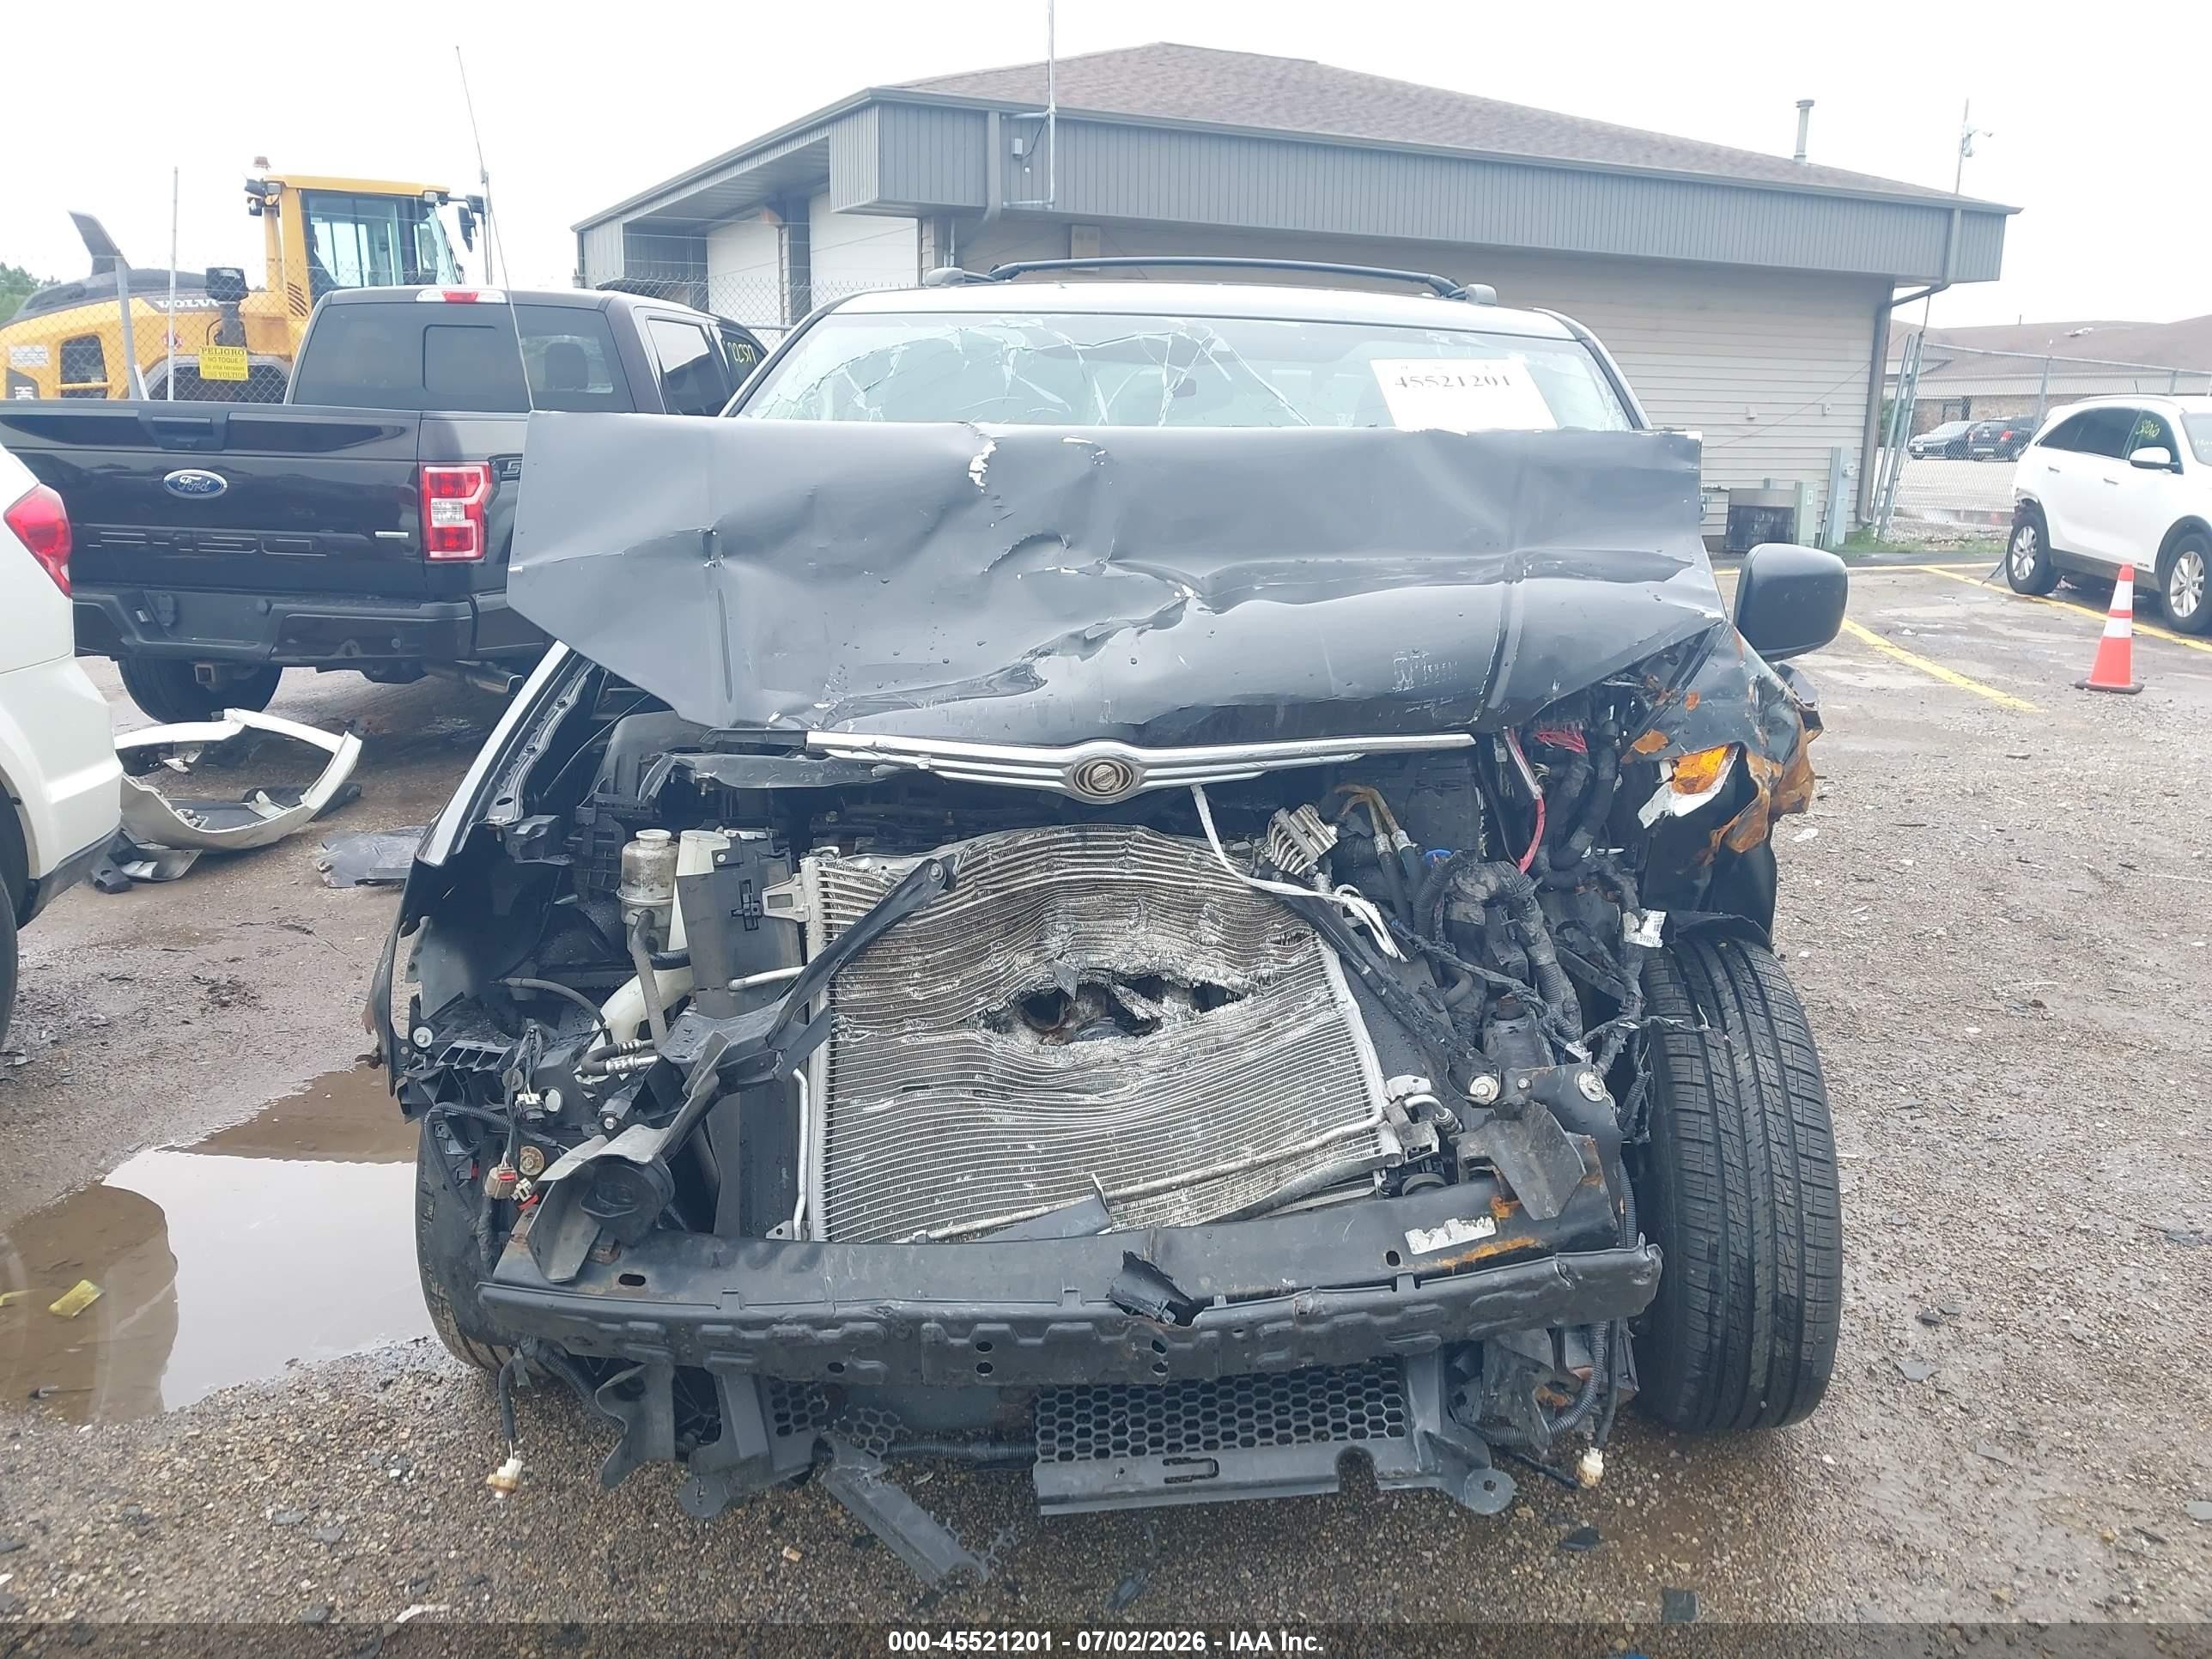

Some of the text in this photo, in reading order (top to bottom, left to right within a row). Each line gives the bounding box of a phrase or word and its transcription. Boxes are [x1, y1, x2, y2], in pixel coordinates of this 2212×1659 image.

[201, 347, 245, 356] PELIGRO
[1395, 374, 1511, 388] 45521201
[179, 475, 211, 492] Ford
